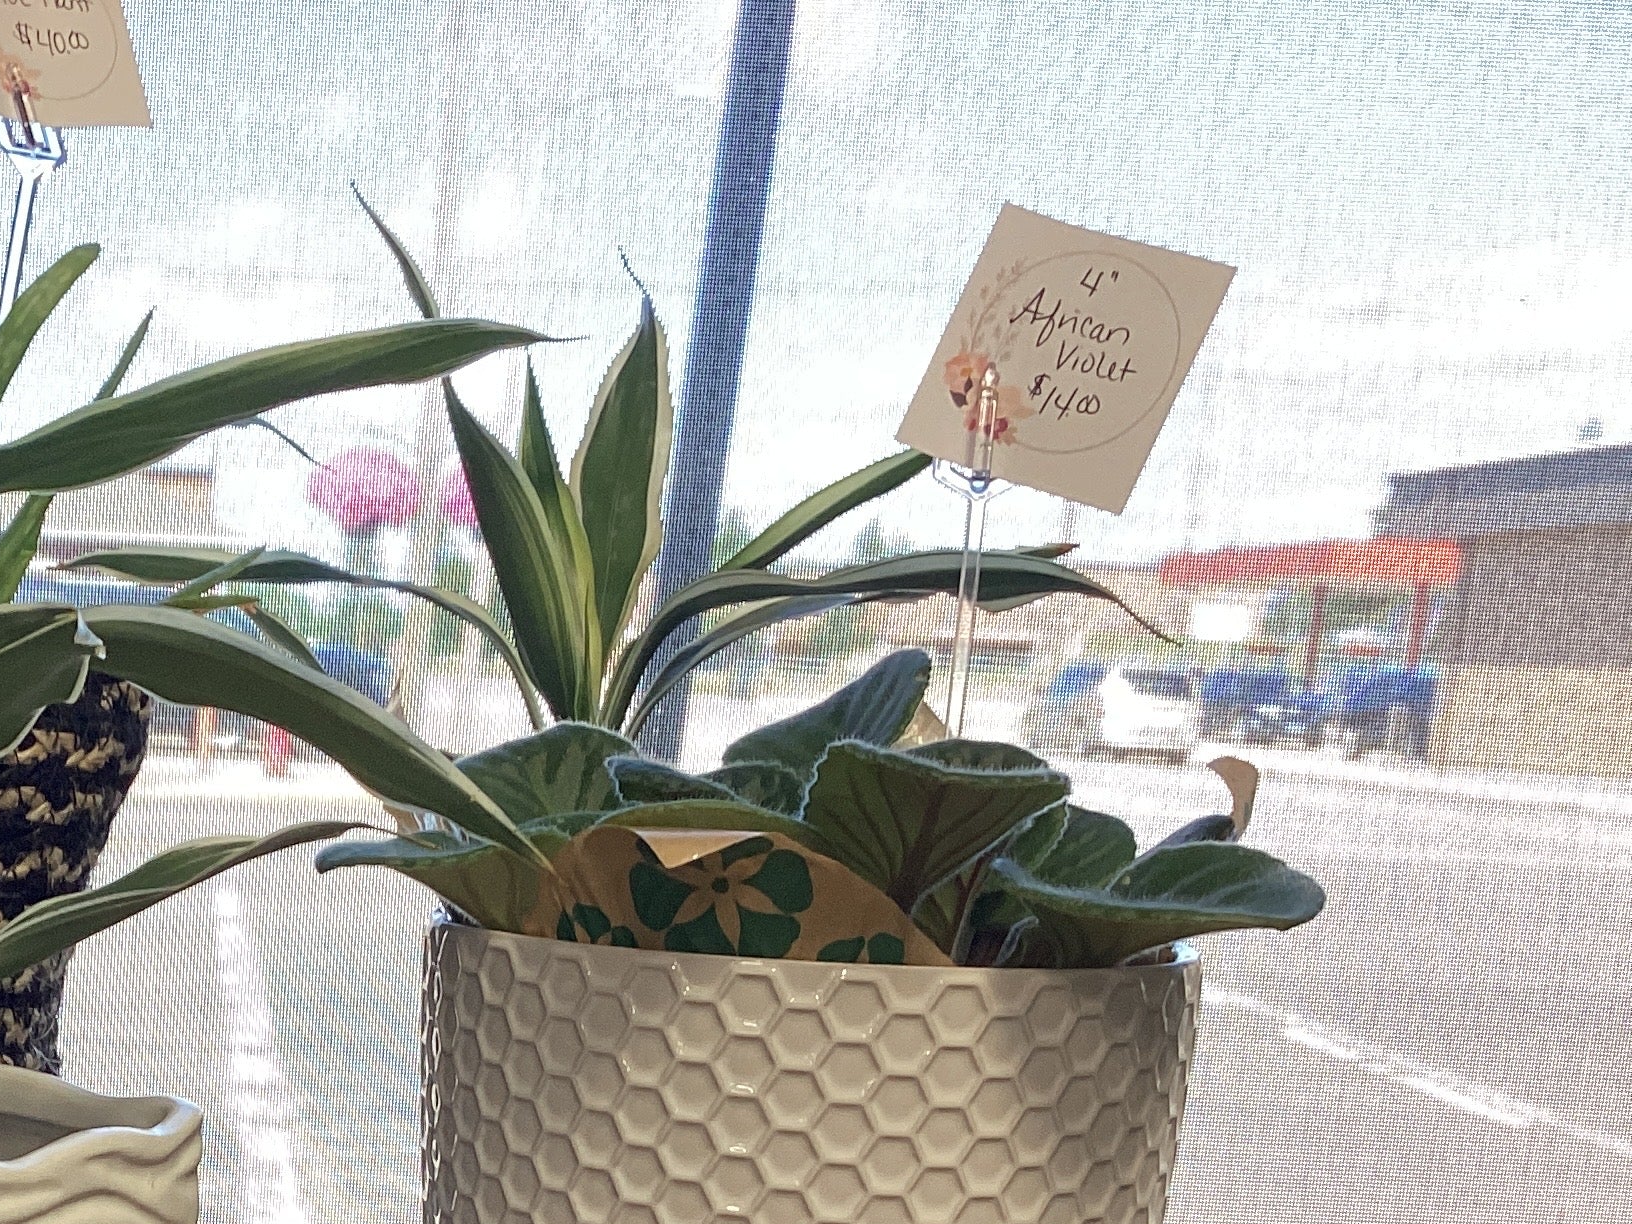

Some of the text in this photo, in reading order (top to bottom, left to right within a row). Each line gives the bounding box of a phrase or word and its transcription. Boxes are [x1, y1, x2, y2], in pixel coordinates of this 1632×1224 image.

[13, 21, 90, 56] $40.00
[1079, 267, 1120, 297] 4"
[1009, 286, 1131, 347] African
[1055, 339, 1137, 382] Violet
[1027, 373, 1101, 420] $14.00
